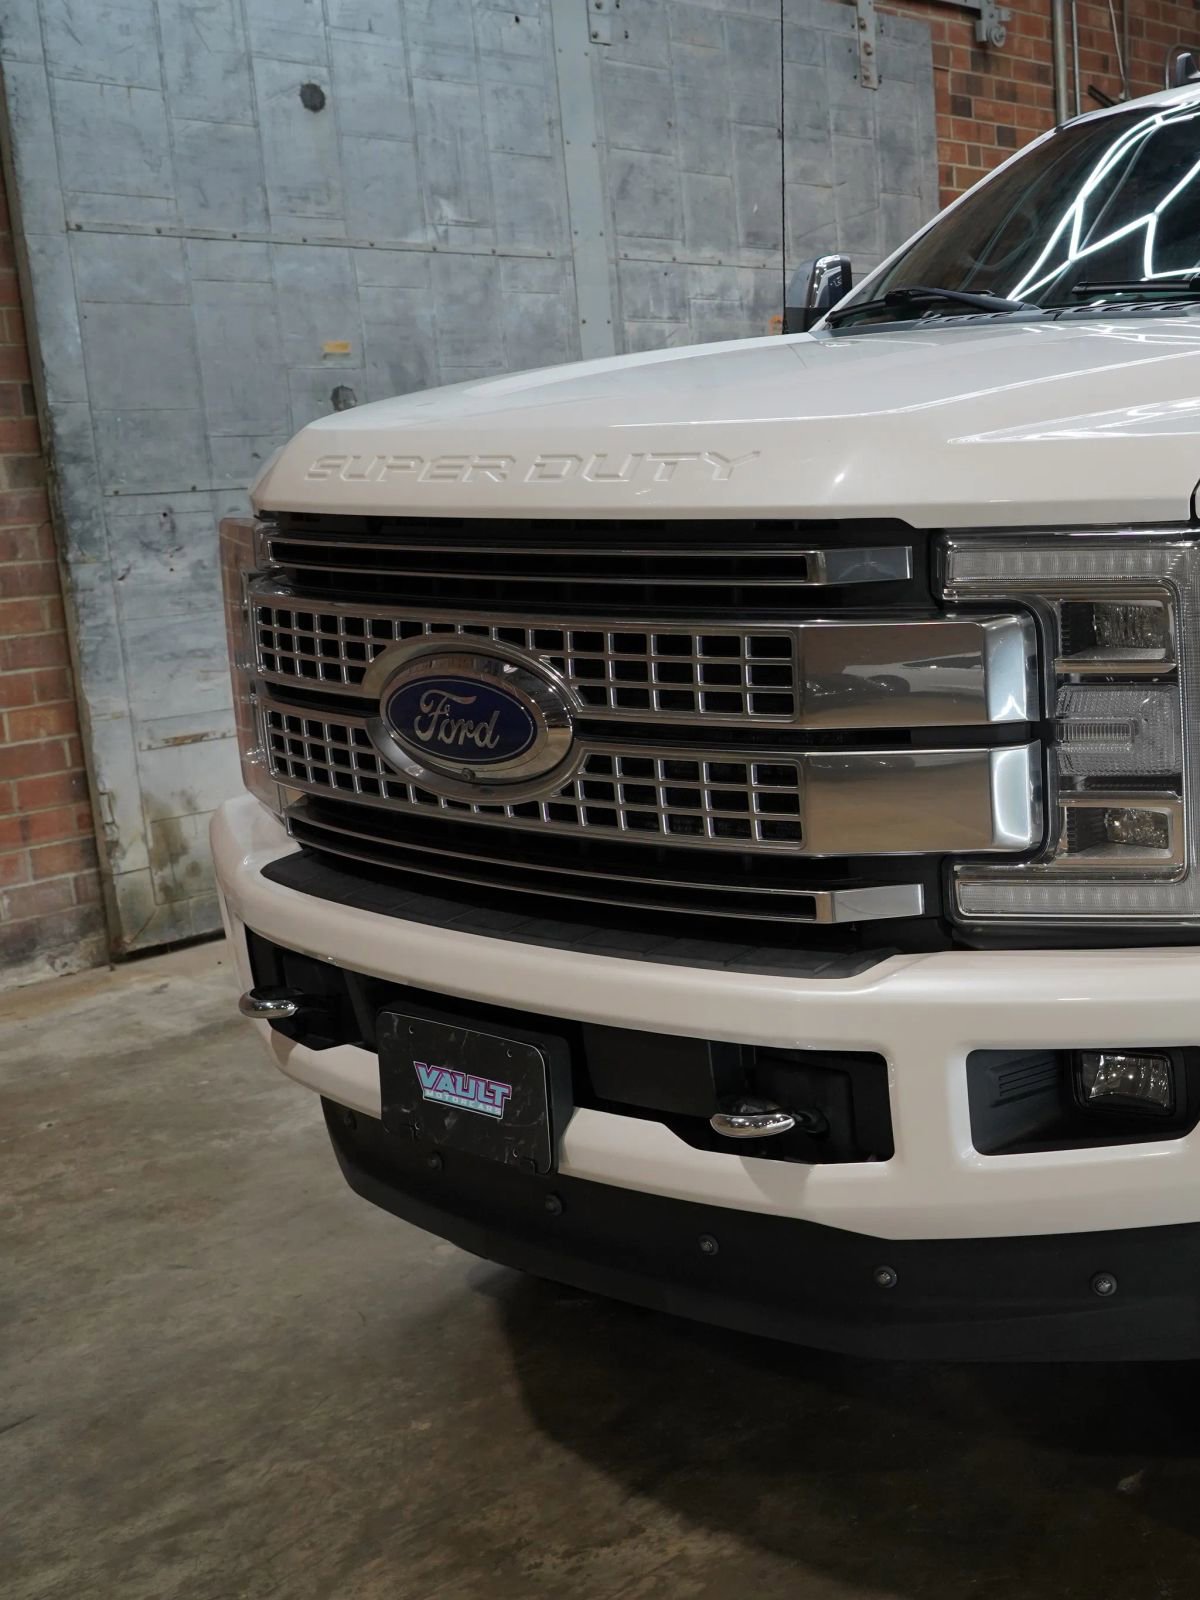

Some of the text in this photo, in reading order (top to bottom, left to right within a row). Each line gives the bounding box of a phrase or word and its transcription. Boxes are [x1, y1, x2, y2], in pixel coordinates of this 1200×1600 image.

[304, 450, 761, 483] SUPER DUTY
[413, 688, 501, 750] Ford
[414, 1062, 512, 1107] VAULT
[423, 1089, 502, 1116] MOTORCARS
